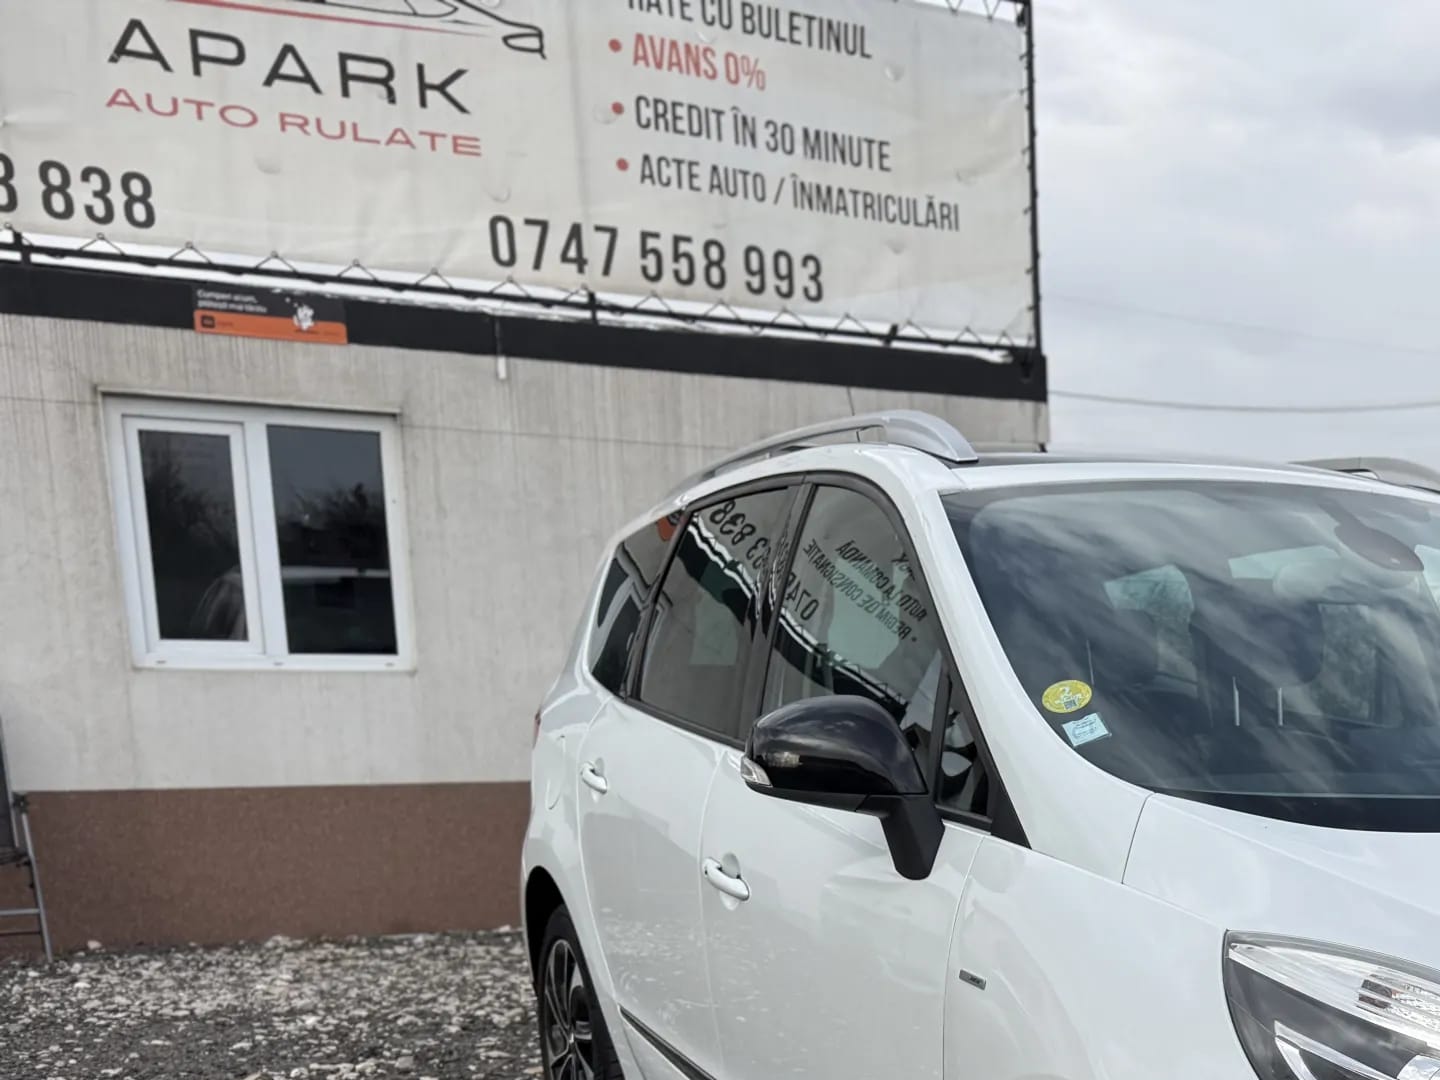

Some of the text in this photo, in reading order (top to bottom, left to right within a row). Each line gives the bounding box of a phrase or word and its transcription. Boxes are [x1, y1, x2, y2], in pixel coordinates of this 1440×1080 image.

[633, 33, 766, 91] AVANS 0%
[701, 0, 733, 30] CU
[741, 1, 872, 59] BULETINUL
[108, 18, 471, 115] APARK
[105, 88, 482, 157] AUTO RULATE
[635, 95, 892, 172] CREDIT ÎN 30 MINUTE
[38, 160, 156, 229] 838
[640, 154, 960, 232] ACTE AUTO / ÎNMATRICULĂRI
[489, 215, 824, 302] 0747 558 993
